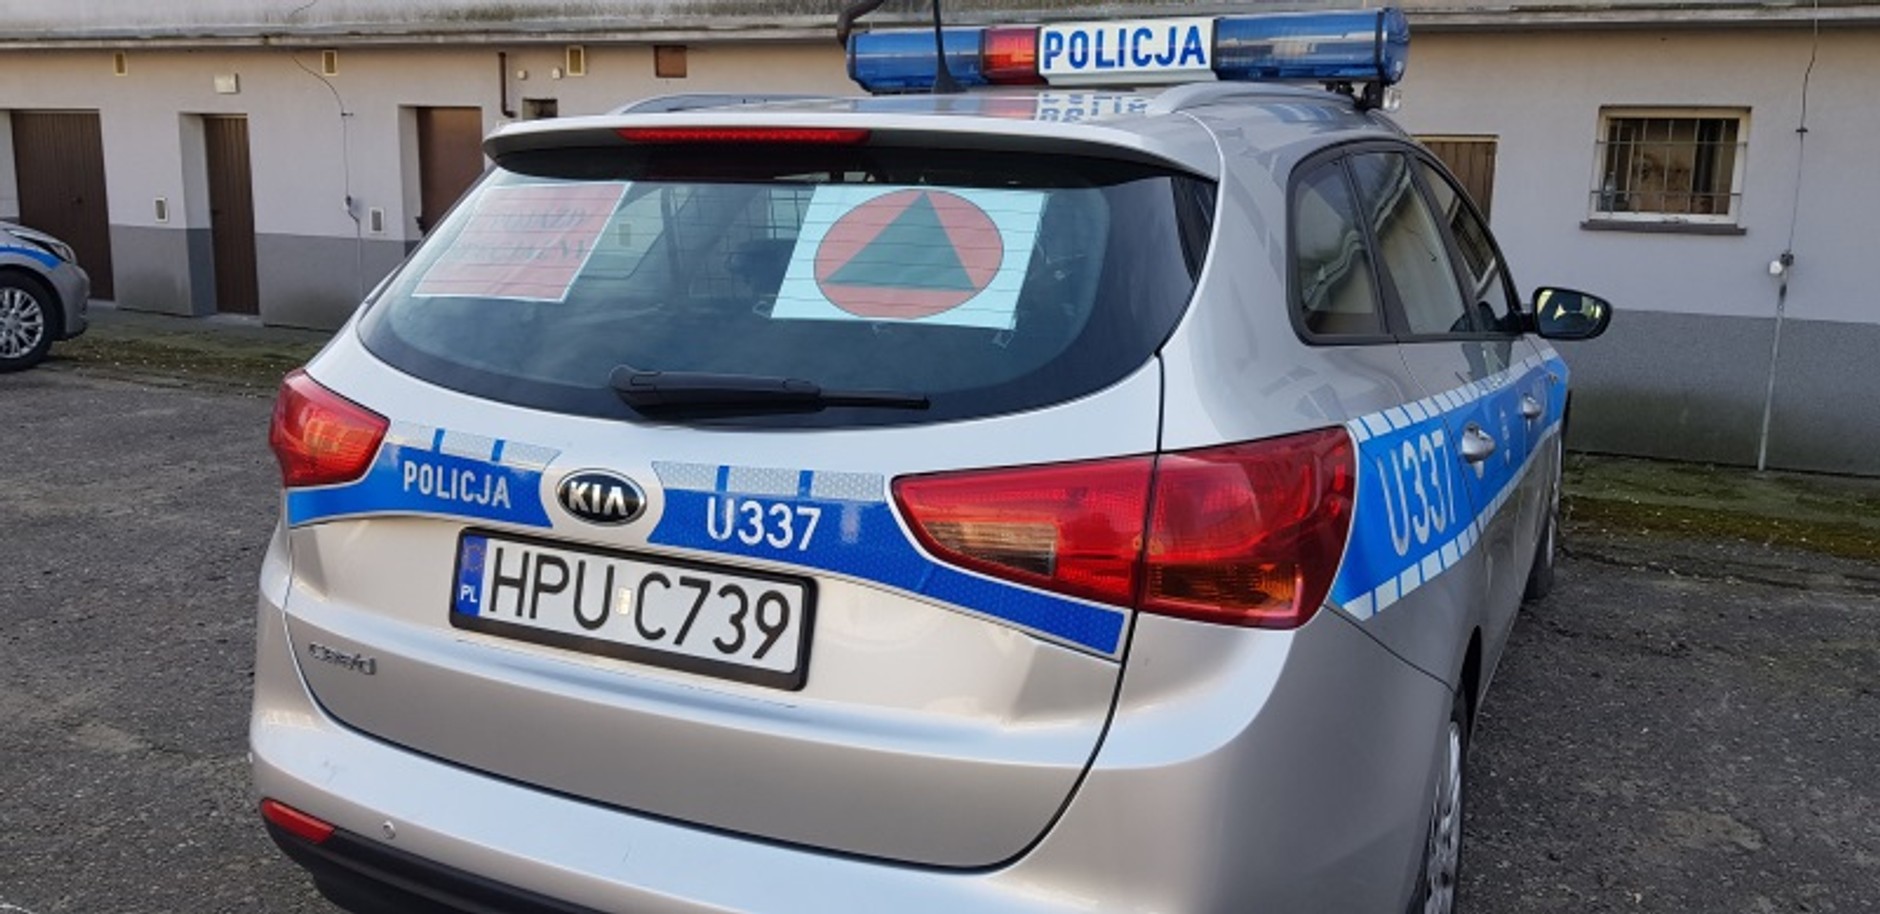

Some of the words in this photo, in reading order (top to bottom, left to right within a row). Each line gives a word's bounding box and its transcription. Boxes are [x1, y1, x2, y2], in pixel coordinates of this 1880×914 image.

[1043, 24, 1207, 70] POLICJA
[402, 460, 513, 510] POLICJA
[567, 484, 628, 518] KIA
[1377, 428, 1456, 557] U337
[706, 497, 822, 551] U337
[460, 584, 478, 603] PL
[489, 546, 616, 631] HPU
[633, 571, 792, 660] C739
